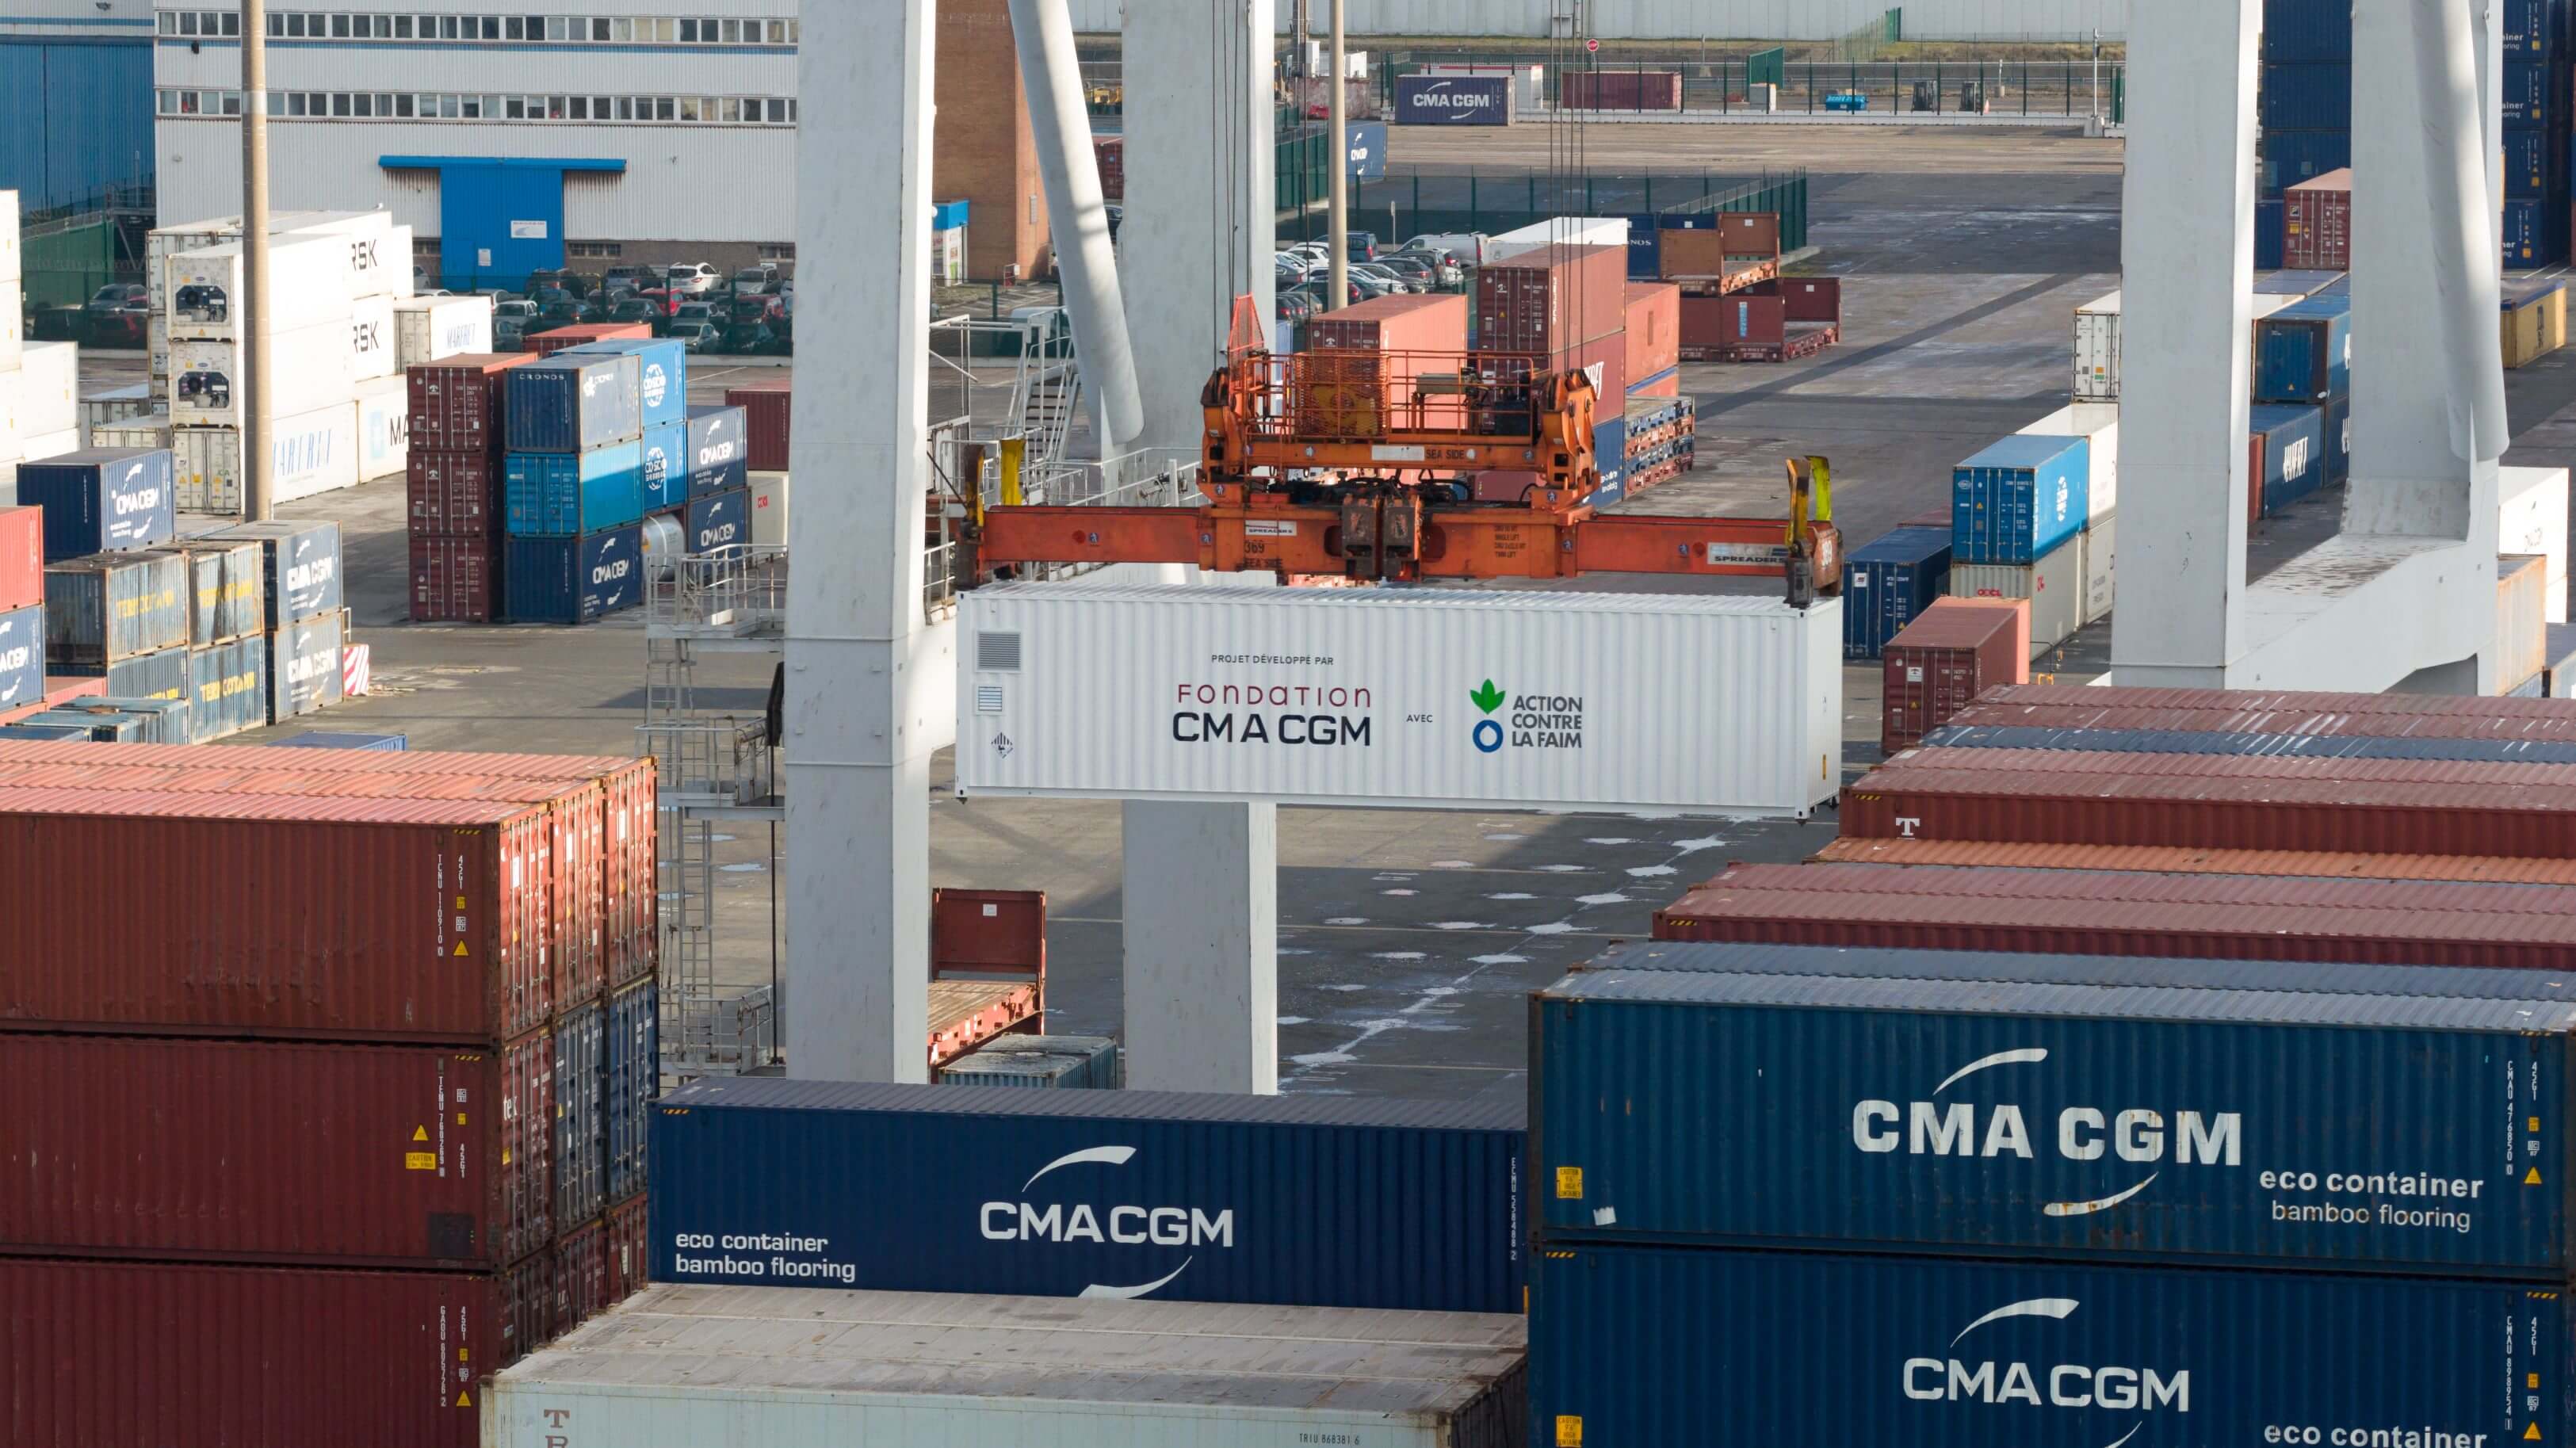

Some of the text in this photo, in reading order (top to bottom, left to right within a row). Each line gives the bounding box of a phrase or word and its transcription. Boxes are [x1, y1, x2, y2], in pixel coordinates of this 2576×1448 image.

[1413, 94, 1489, 107] CMA CGM
[1427, 449, 1465, 460] SEA SIDE
[1211, 655, 1249, 663] PROJET
[1315, 656, 1333, 665] PAR
[1512, 695, 1582, 713] ACTION
[1173, 712, 1370, 746] CMA CGM
[1512, 713, 1582, 730] CONTRE
[1512, 731, 1582, 748] LA FAIM
[1853, 1099, 2242, 1166] CMA CGM
[2260, 1171, 2484, 1200] eco container
[980, 1202, 1233, 1247] CMA CGM
[2272, 1199, 2471, 1233] bamboo flooring
[675, 1232, 828, 1252] eco container
[675, 1253, 856, 1283] bamboo flooring
[1903, 1358, 2190, 1412] CMA CGM
[1299, 1433, 1318, 1444] TRIU
[2264, 1425, 2487, 1448] eco container
